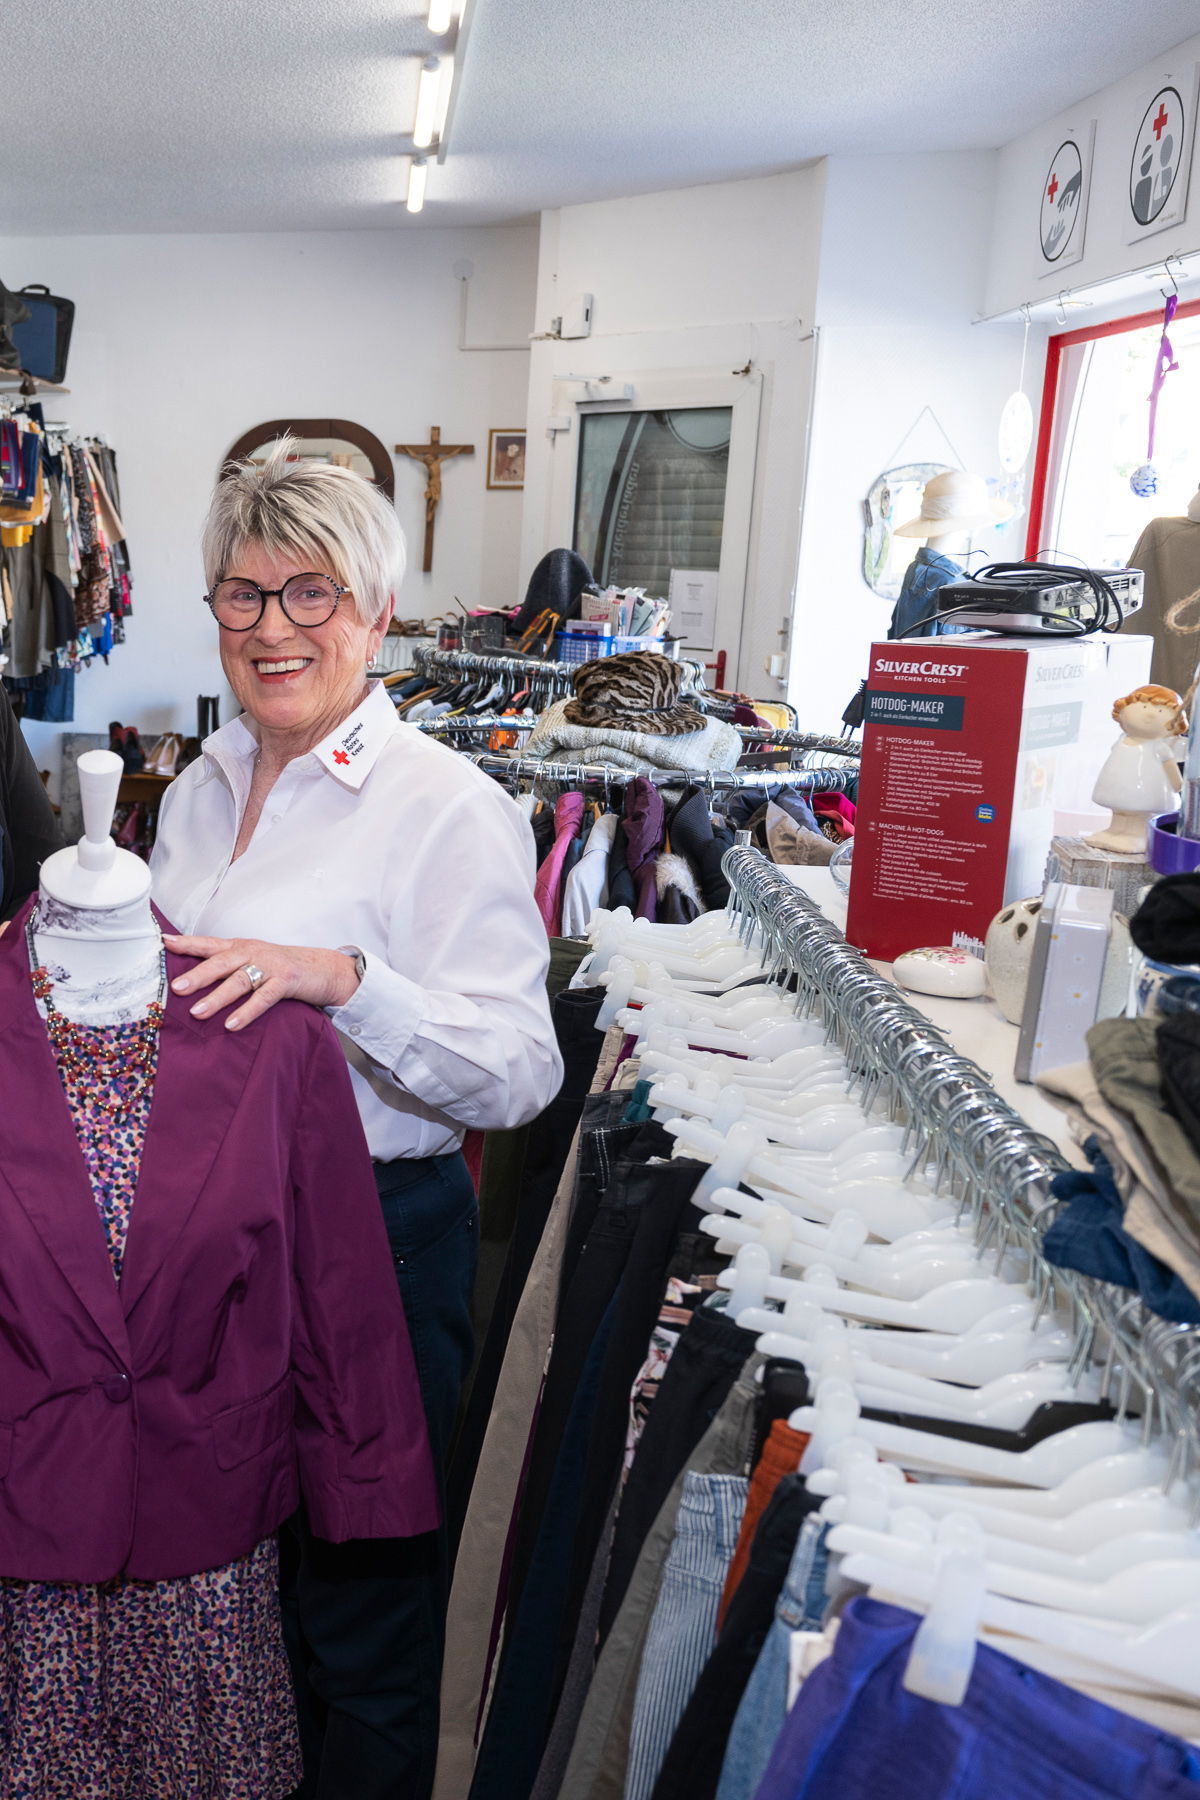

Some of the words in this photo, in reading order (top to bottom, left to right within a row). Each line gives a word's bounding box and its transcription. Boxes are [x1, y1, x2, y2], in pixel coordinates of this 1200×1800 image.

[874, 658, 966, 678] SILVERCREST
[871, 697, 944, 715] HOTDOG-MAKER
[886, 737, 935, 746] HOTDOG-MAKER
[879, 822, 906, 831] MACHINE
[912, 827, 944, 836] HOT-DOGS
